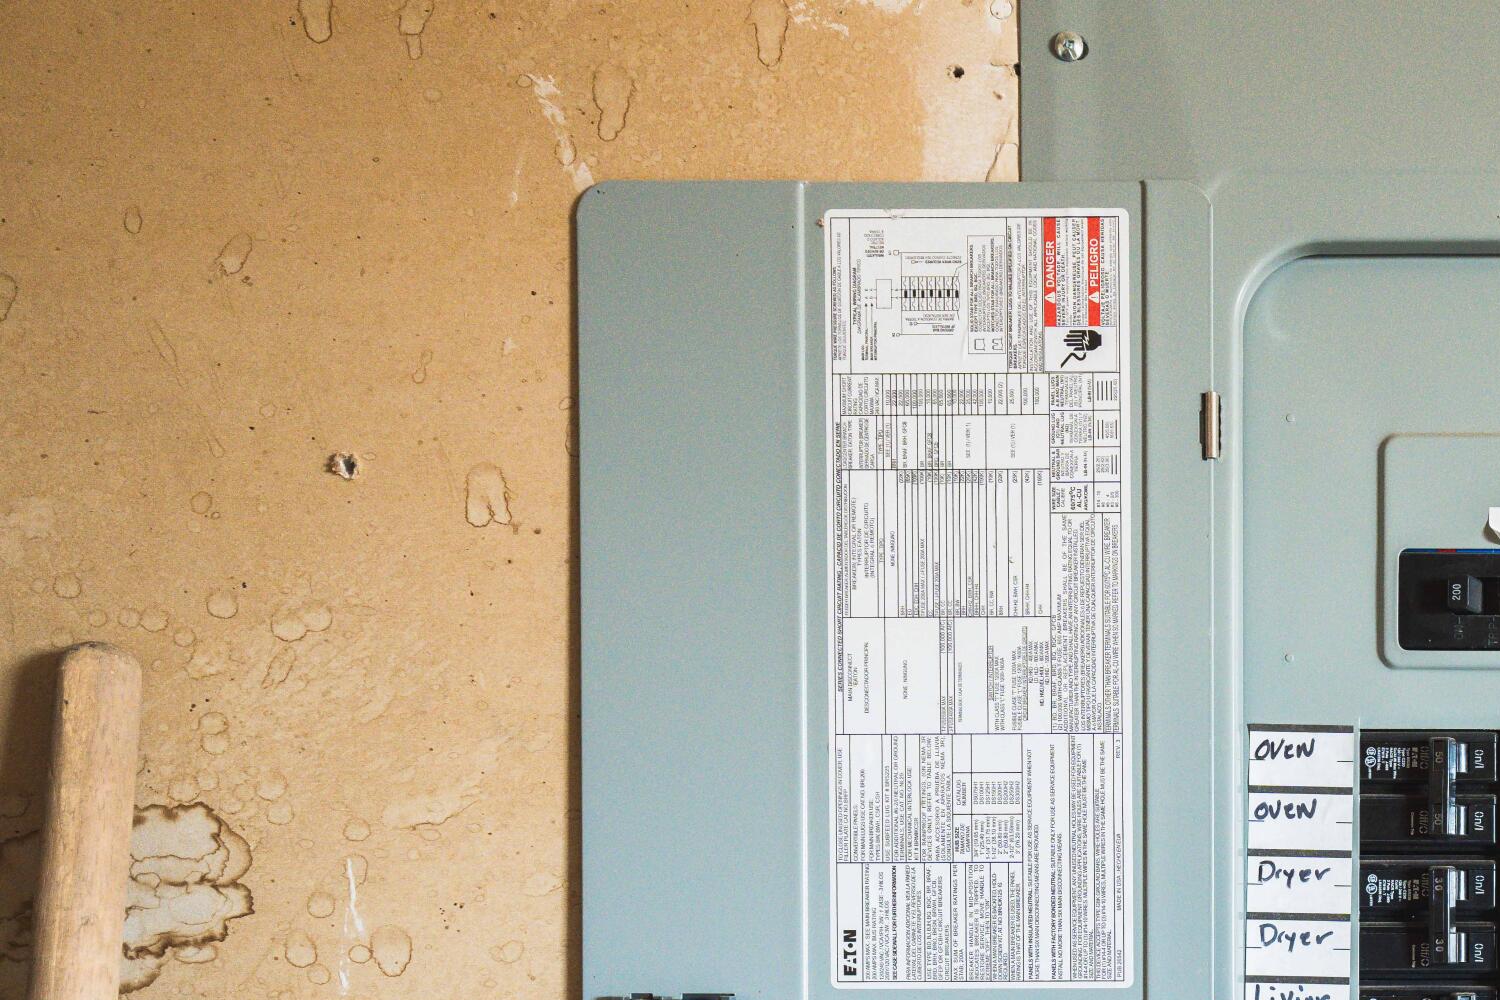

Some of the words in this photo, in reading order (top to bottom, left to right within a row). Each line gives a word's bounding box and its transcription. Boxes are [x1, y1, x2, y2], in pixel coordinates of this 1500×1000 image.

[1046, 241, 1055, 287] DANGER
[1090, 239, 1098, 287] PELIGRO
[1452, 583, 1461, 600] 200
[1258, 860, 1331, 889] Dryer
[1259, 923, 1334, 952] Dryer
